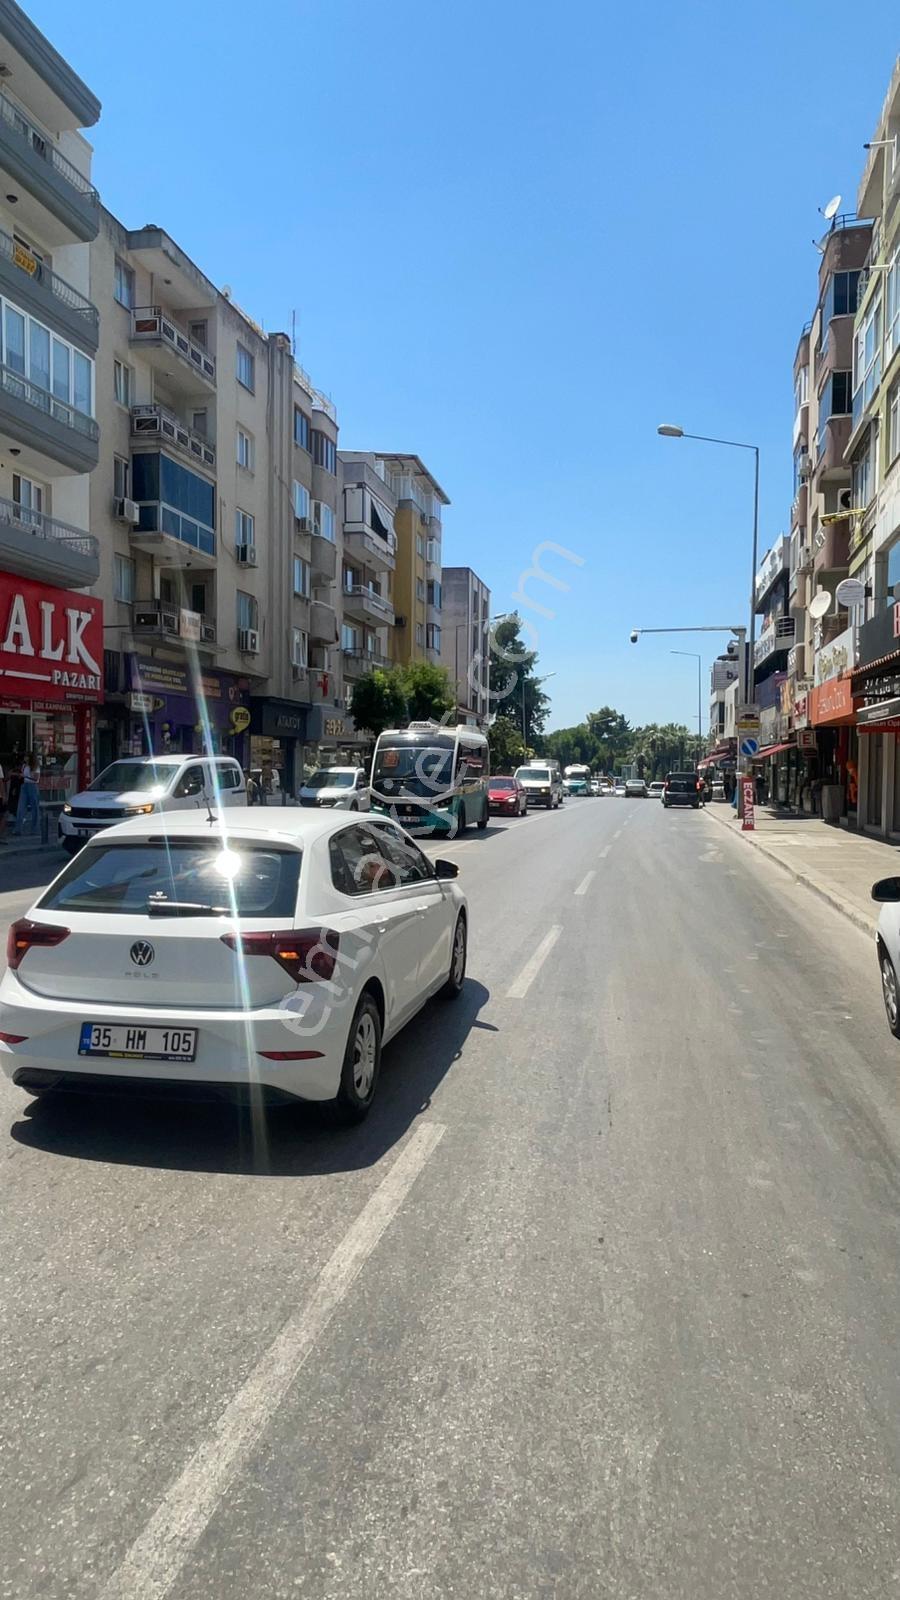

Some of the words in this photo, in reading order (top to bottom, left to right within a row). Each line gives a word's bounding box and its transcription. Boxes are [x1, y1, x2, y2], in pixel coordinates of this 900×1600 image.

[53, 669, 101, 691] PAZARI
[743, 782, 754, 825] ECZANE
[92, 1028, 112, 1048] 35
[126, 1029, 147, 1050] HM
[162, 1031, 192, 1052] 105
